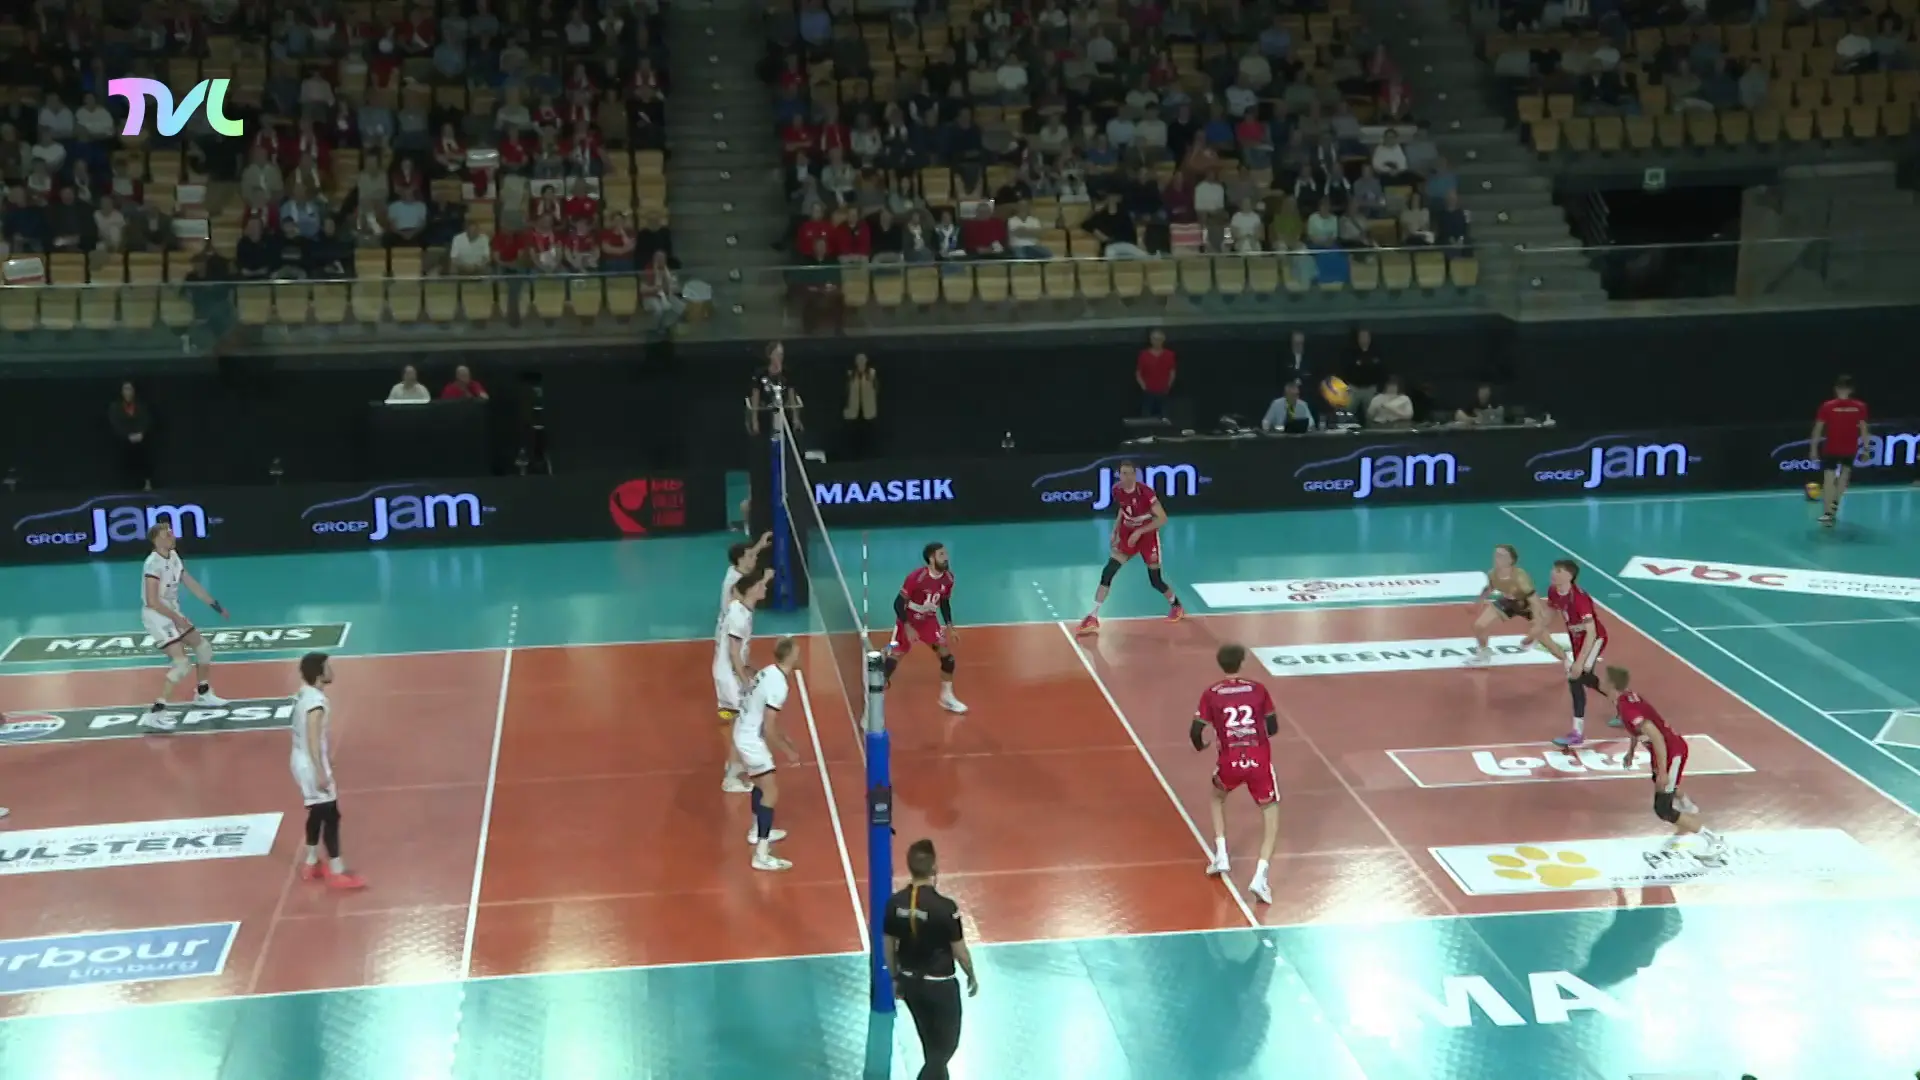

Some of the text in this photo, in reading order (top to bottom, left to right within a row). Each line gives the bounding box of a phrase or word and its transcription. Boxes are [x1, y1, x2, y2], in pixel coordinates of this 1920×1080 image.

[1303, 452, 1456, 498] GROEP jam
[1533, 442, 1687, 488] GROEP jam
[815, 478, 954, 504] MAASEIK
[312, 493, 481, 540] GROEP jam
[26, 532, 87, 545] GROEP
[1641, 563, 1788, 586] vbc
[45, 628, 313, 652] MAENS
[1223, 705, 1255, 727] 22
[0, 937, 209, 971] rbour
[69, 959, 198, 979] Limburg
